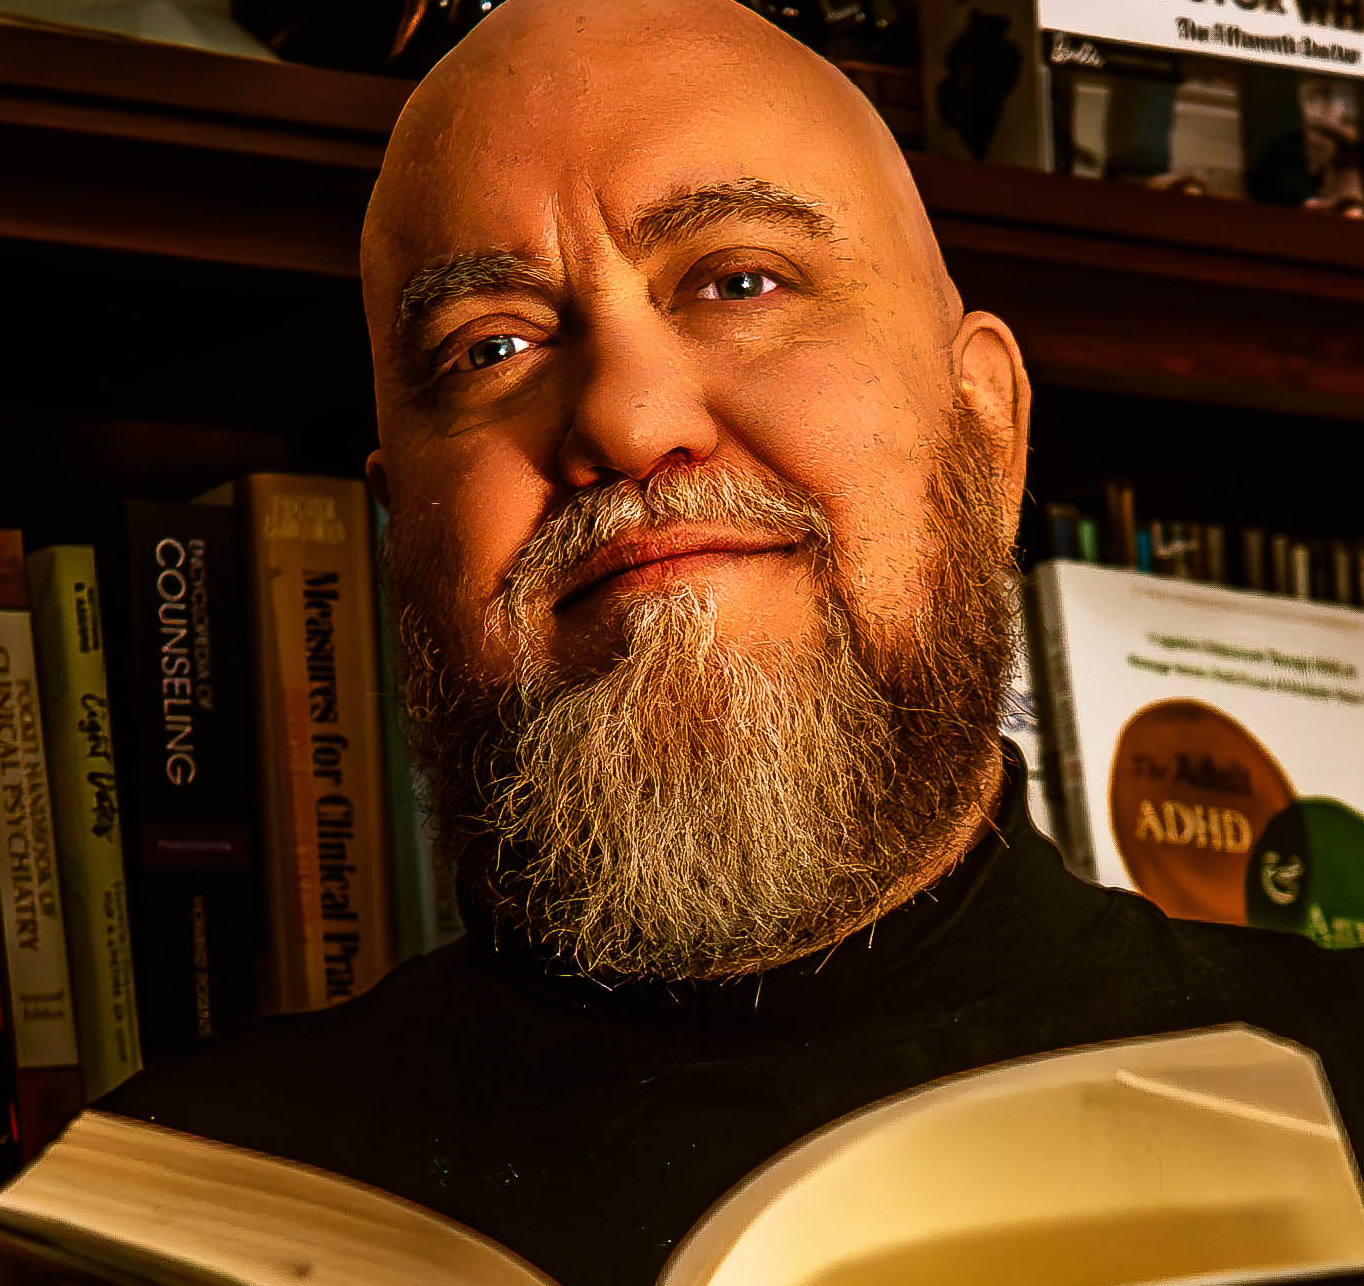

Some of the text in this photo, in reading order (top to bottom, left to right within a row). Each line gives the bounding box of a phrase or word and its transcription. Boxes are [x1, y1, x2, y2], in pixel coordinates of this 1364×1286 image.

[154, 536, 198, 788] COUNSELING
[301, 567, 338, 725] Measures
[309, 732, 350, 794] for
[1135, 797, 1254, 853] ADHD
[2, 783, 39, 953] PSYCHIATRY
[316, 793, 357, 920] Clinical
